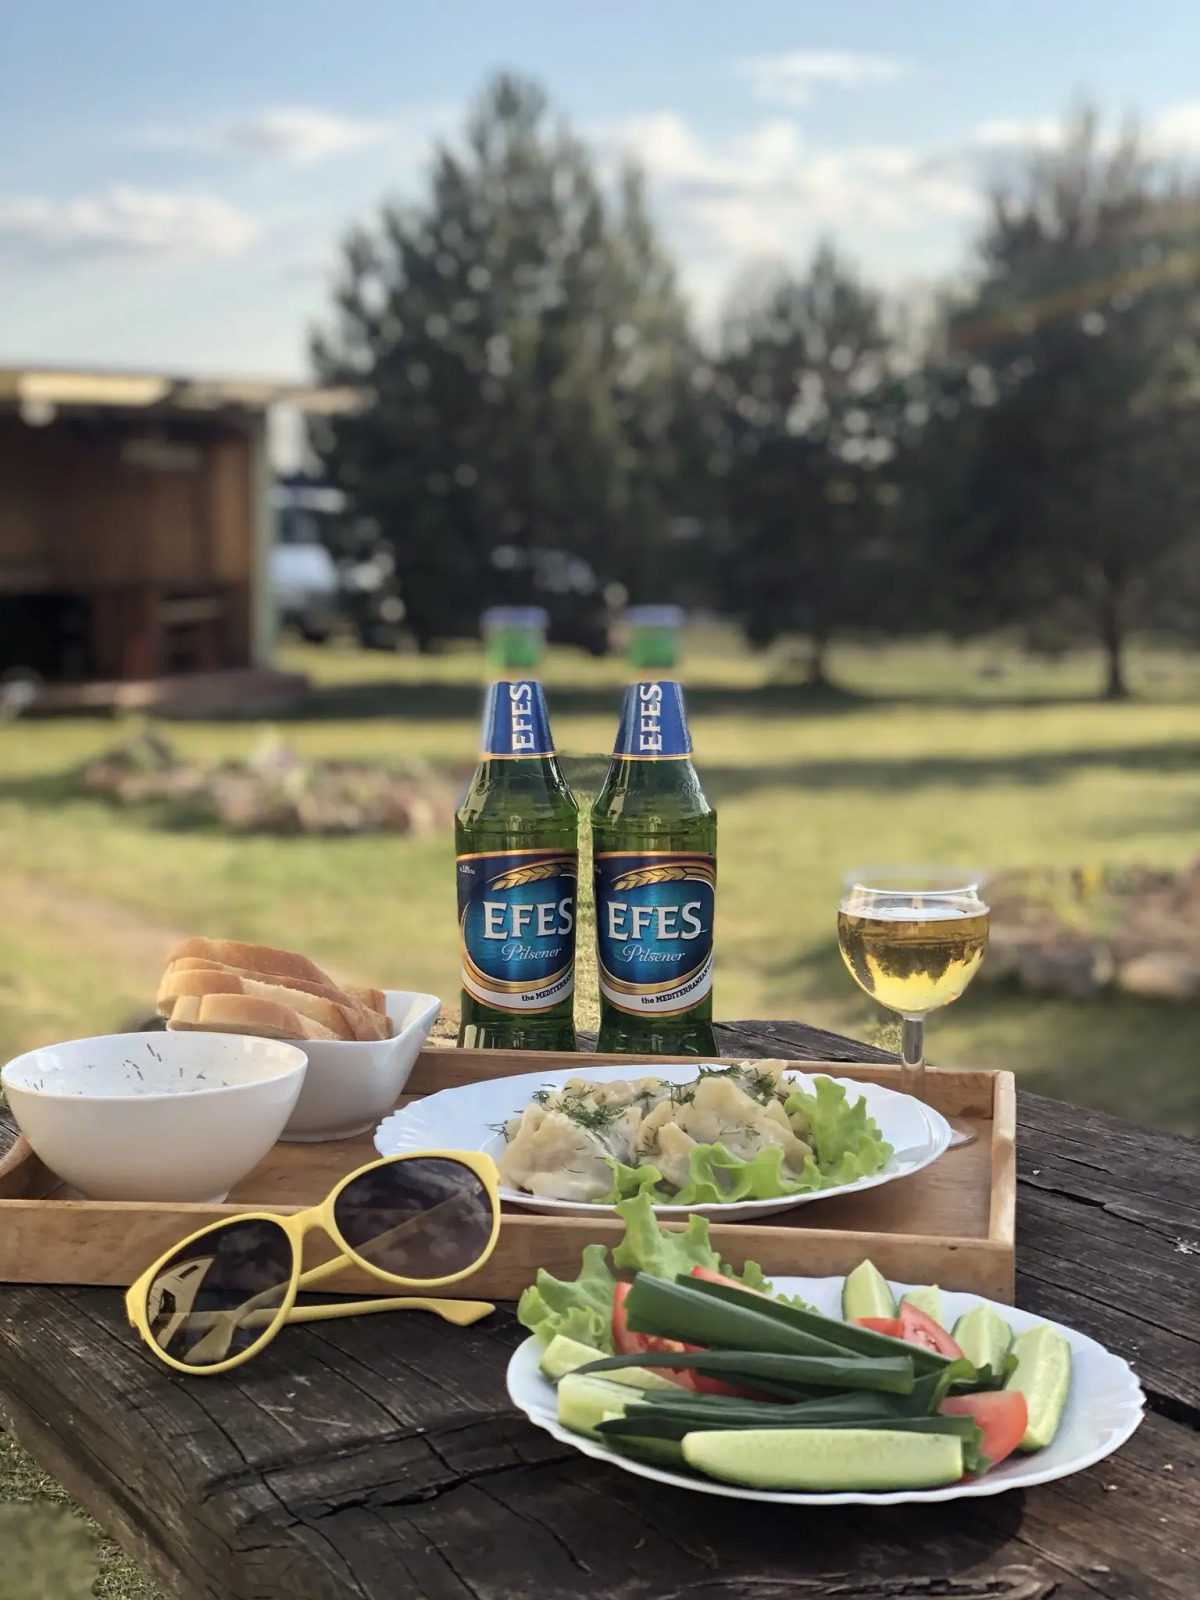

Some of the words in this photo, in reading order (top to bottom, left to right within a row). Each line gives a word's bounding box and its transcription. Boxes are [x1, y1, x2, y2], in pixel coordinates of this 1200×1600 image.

[509, 683, 535, 751] EFES
[639, 683, 663, 752] EFES
[483, 898, 573, 940] EFES
[607, 901, 703, 941] EFES
[501, 942, 562, 962] Pilsener
[622, 943, 686, 963] Pilsener
[521, 994, 535, 1002] the
[641, 996, 655, 1004] the
